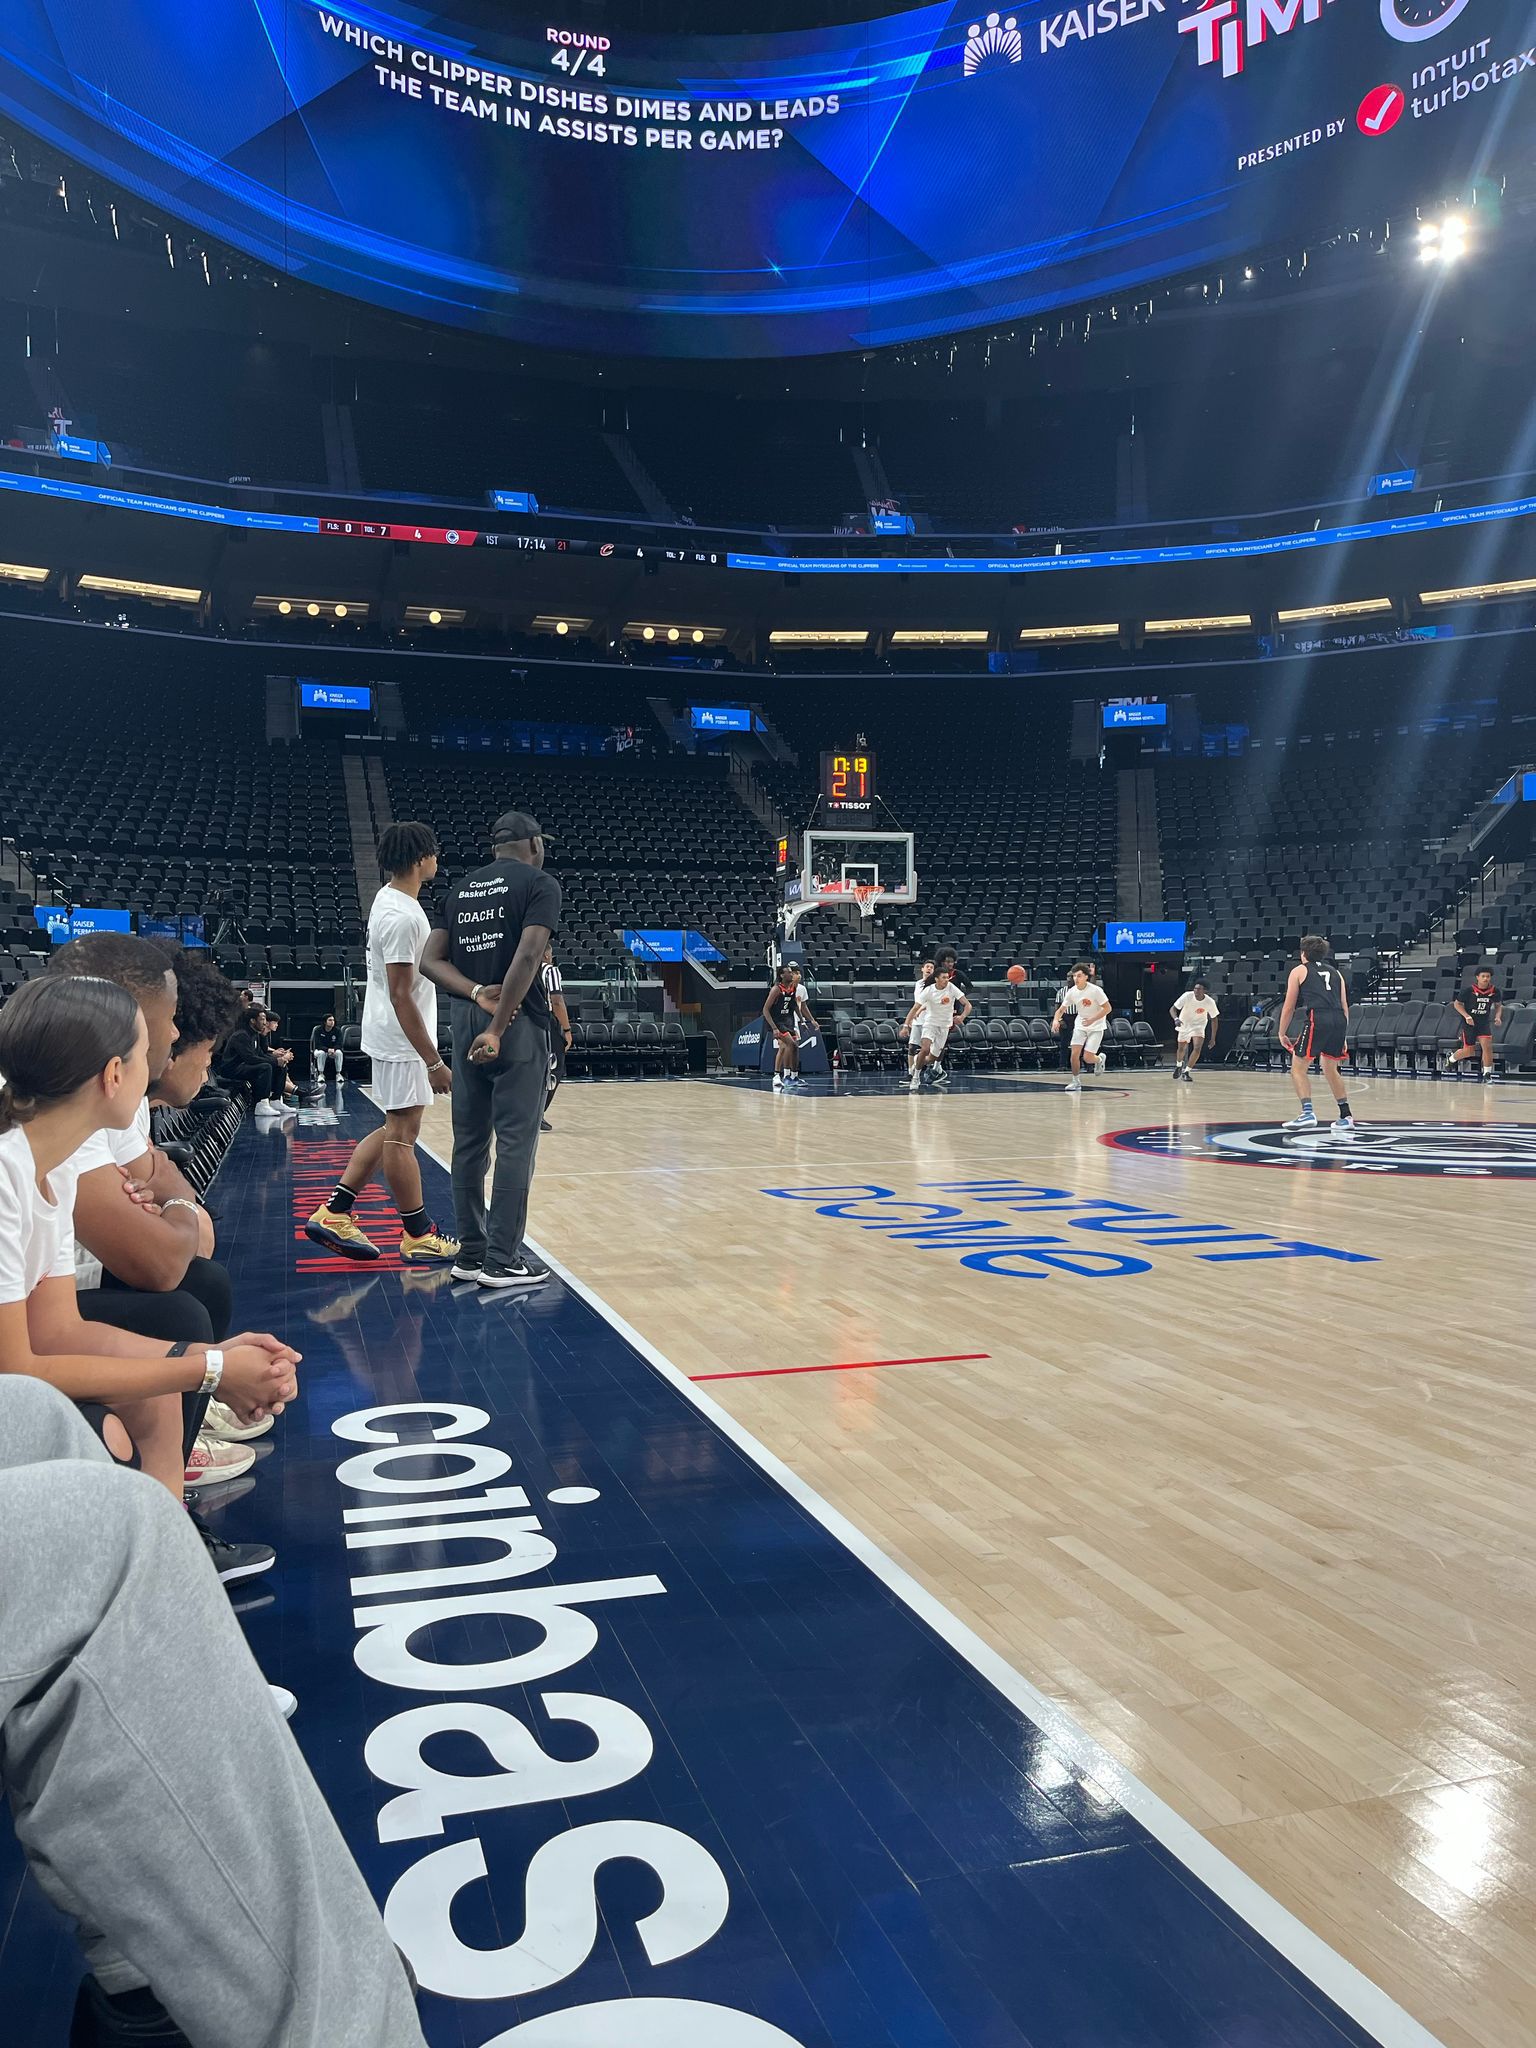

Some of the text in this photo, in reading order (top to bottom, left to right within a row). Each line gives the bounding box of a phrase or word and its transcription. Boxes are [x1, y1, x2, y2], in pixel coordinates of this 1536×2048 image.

[546, 27, 611, 51] ROUND
[318, 11, 840, 123] WHICH CLIPPER DISHES DIMES AND LEADS
[551, 48, 606, 78] 4/4
[1411, 38, 1491, 89] INTUIT
[1410, 47, 1536, 118] turbotax
[374, 64, 784, 151] THE TEAM IN ASSISTS PER GAME?
[1237, 118, 1347, 171] PRESENTED BY
[98, 493, 126, 503] OFFICIAL
[127, 498, 143, 506] TEAM
[144, 501, 177, 512] PHYSICIANS
[199, 510, 225, 519] CLIPPERS
[345, 524, 352, 533] 0
[380, 527, 387, 536] 7
[414, 529, 422, 539] 4
[485, 535, 499, 545] 1ST
[517, 537, 546, 551] 17:14
[557, 541, 567, 551] 21
[636, 548, 644, 558] 4
[679, 551, 685, 561] 7
[710, 554, 717, 563] 0
[832, 772, 865, 798] 21
[840, 802, 871, 810] TISSOT
[458, 885, 509, 899] Basket Camp
[458, 908, 494, 924] COACH
[73, 920, 95, 928] KAISER
[459, 931, 504, 945] Intuit Dome
[1317, 971, 1331, 990] 7
[738, 1031, 760, 1045] coinbase
